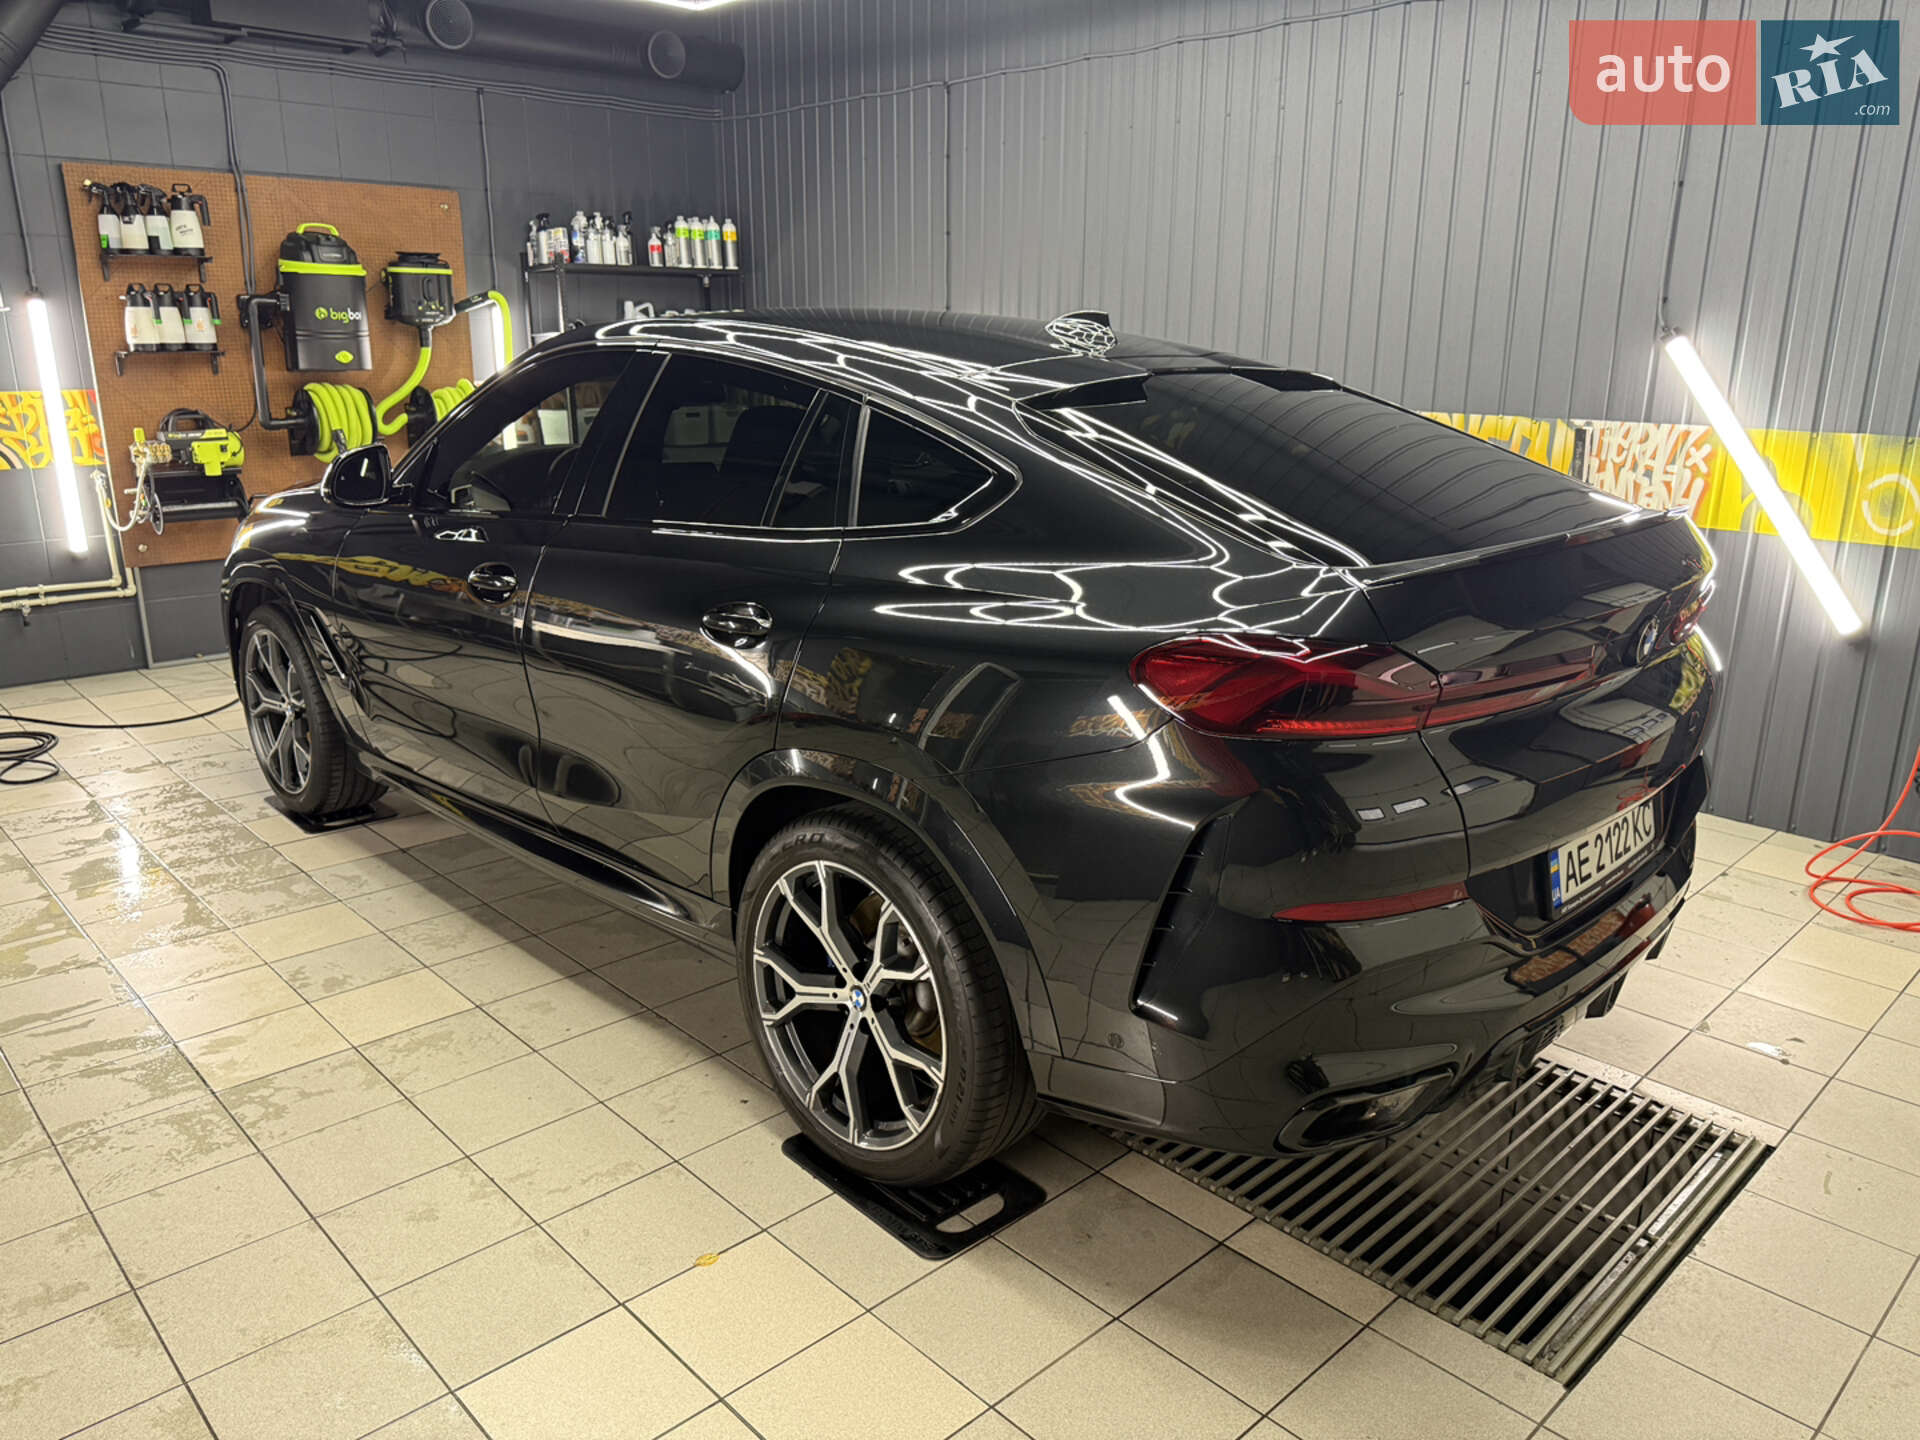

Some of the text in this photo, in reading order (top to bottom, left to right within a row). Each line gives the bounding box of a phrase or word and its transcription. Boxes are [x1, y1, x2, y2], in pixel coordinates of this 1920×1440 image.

[1565, 840, 1592, 893] AE
[1594, 816, 1631, 874] 2122
[1631, 803, 1653, 848] KC
